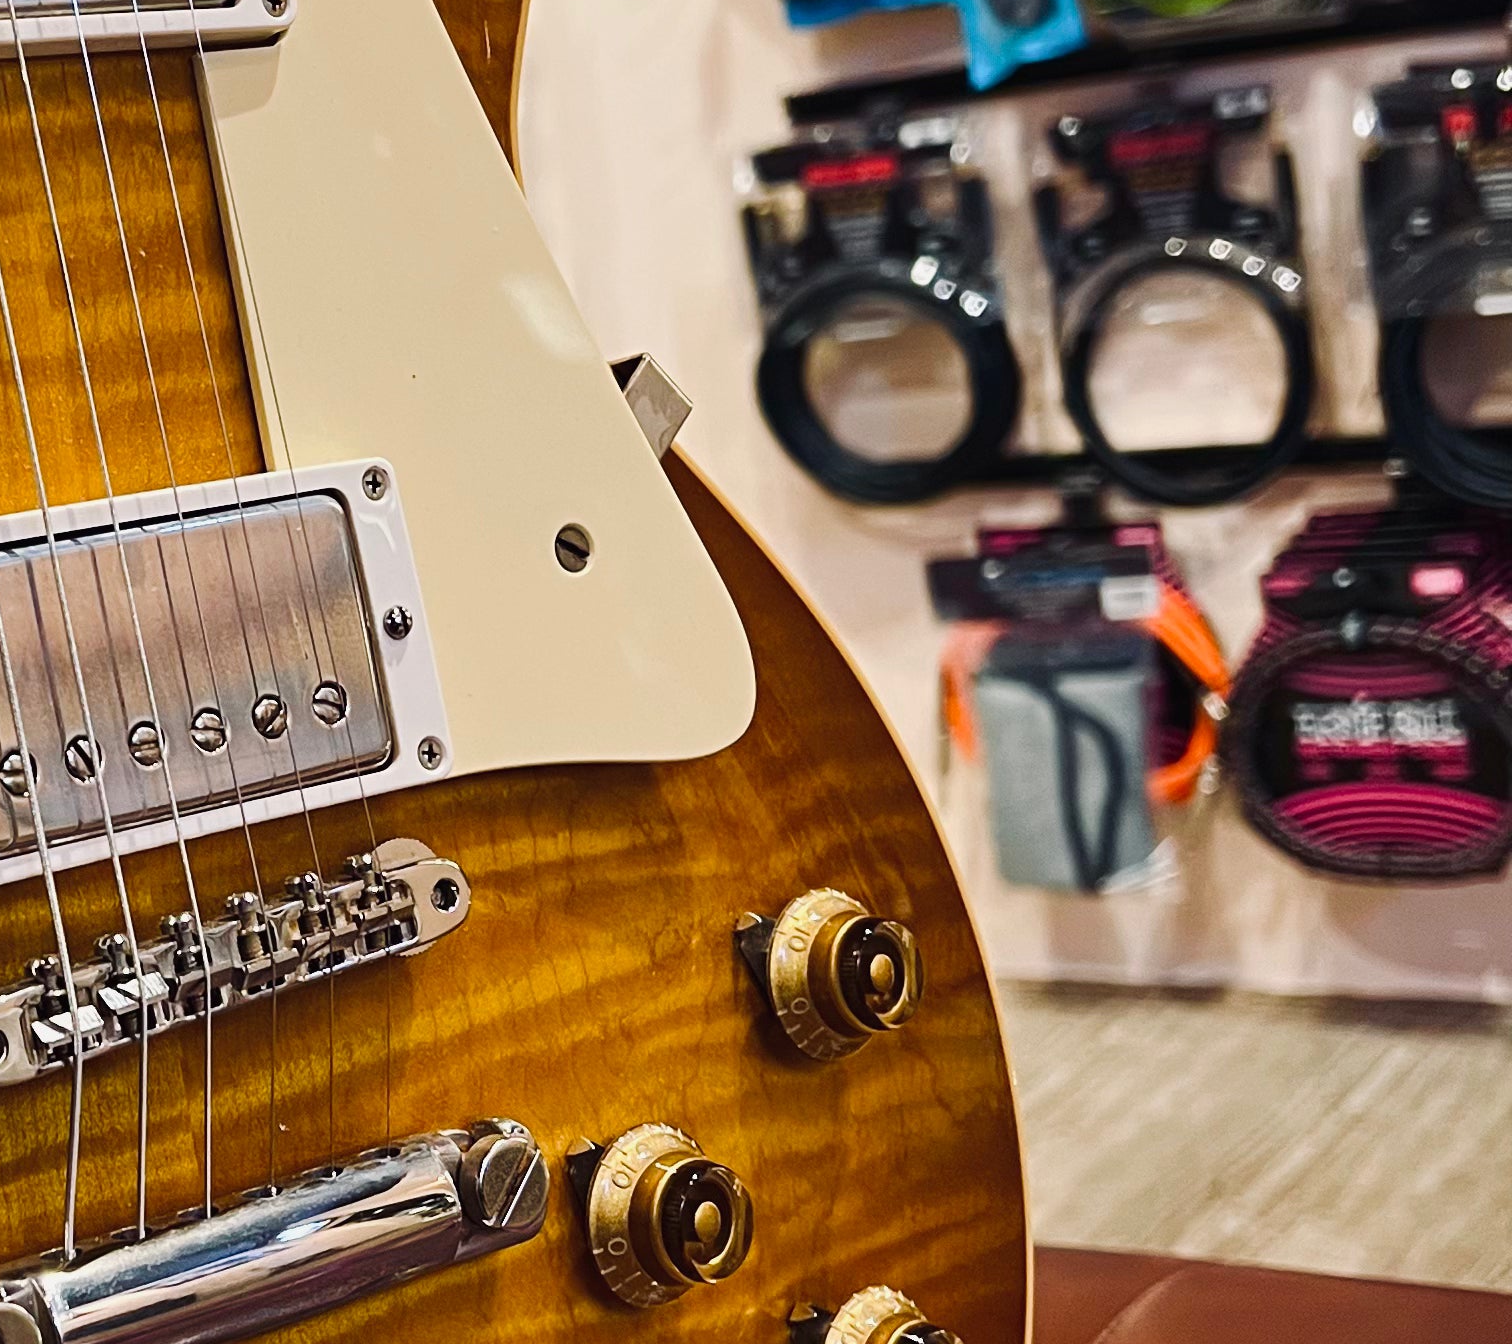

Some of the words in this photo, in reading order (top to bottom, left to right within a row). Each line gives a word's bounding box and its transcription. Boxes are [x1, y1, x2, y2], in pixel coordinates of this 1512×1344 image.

[788, 926, 811, 953] 10
[791, 997, 810, 1015] 0
[611, 1161, 637, 1189] 10
[608, 1237, 628, 1256] 0
